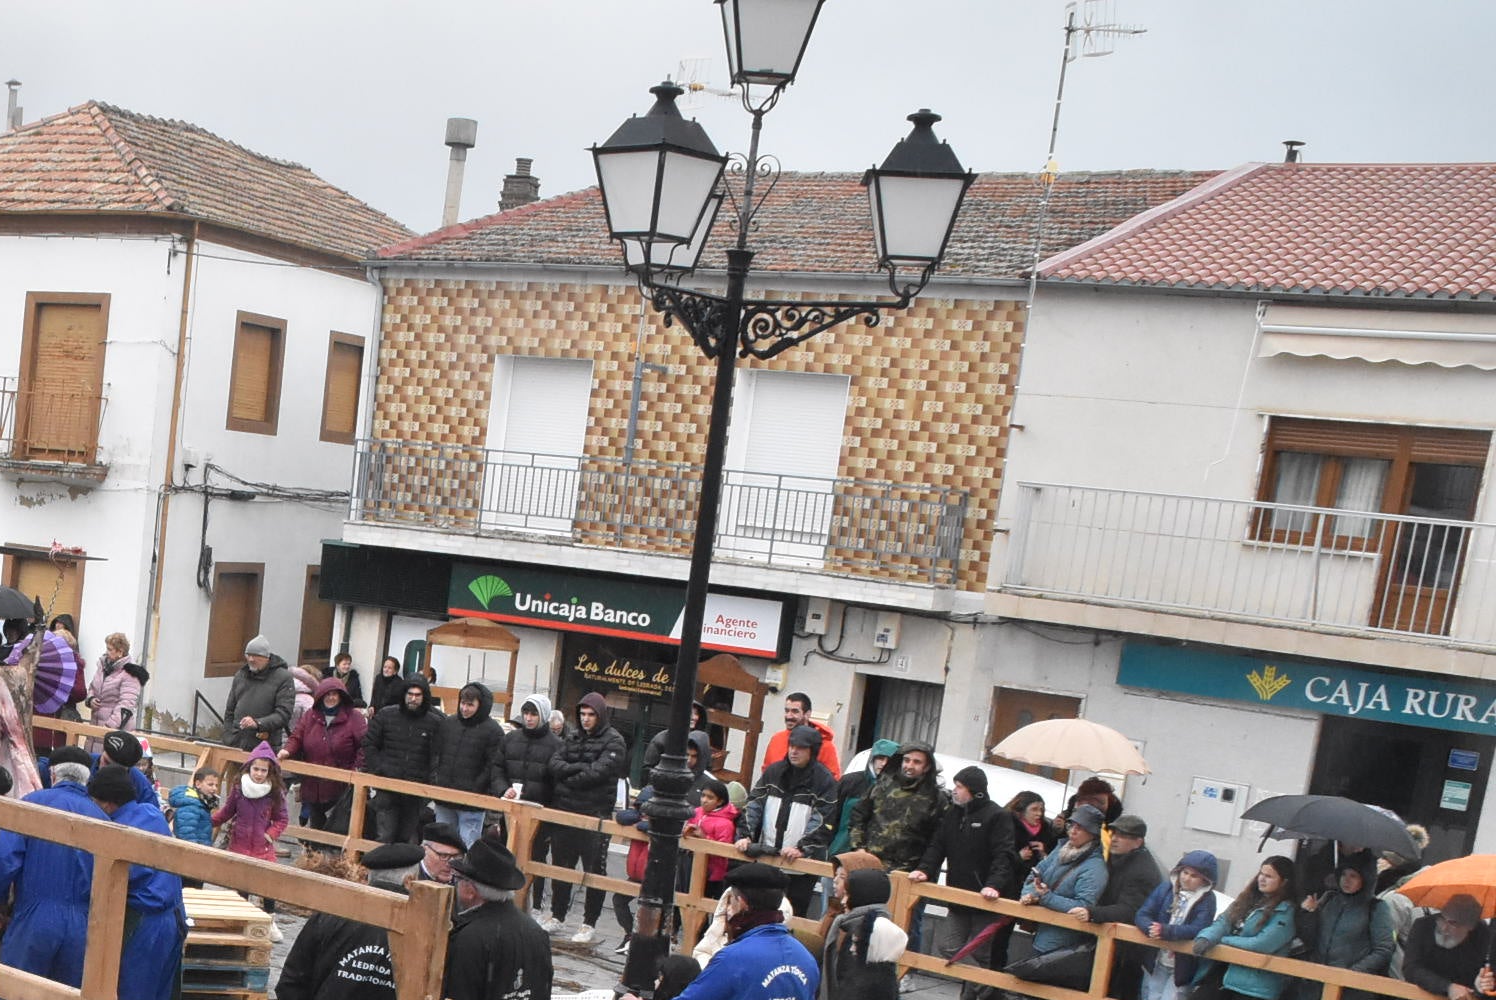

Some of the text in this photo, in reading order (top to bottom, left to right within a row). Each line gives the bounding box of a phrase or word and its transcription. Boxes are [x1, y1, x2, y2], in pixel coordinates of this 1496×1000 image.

[514, 592, 651, 627] Unicaja Banco
[702, 624, 757, 640] inanciero
[715, 614, 758, 629] Agente
[574, 653, 670, 684] Los dulces de
[1305, 676, 1391, 714] CAJA
[338, 945, 385, 967] MATANZA
[761, 965, 790, 988] MATANZA
